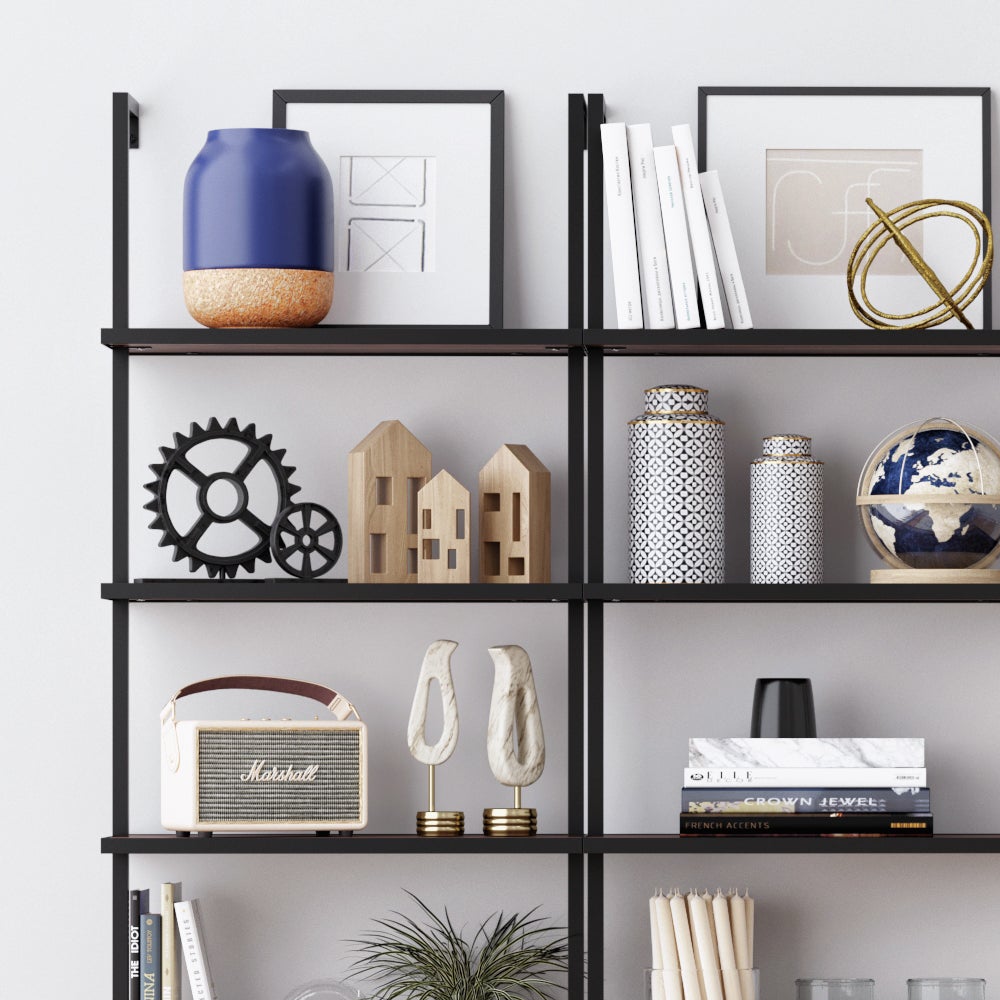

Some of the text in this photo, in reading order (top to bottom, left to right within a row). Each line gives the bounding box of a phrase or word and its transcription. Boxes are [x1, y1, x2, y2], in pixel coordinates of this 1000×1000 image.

[240, 759, 320, 782] Marshall
[743, 797, 813, 806] CROWN
[684, 821, 769, 829] FRENCH ACCENTS
[131, 925, 140, 979] THE IDIOT
